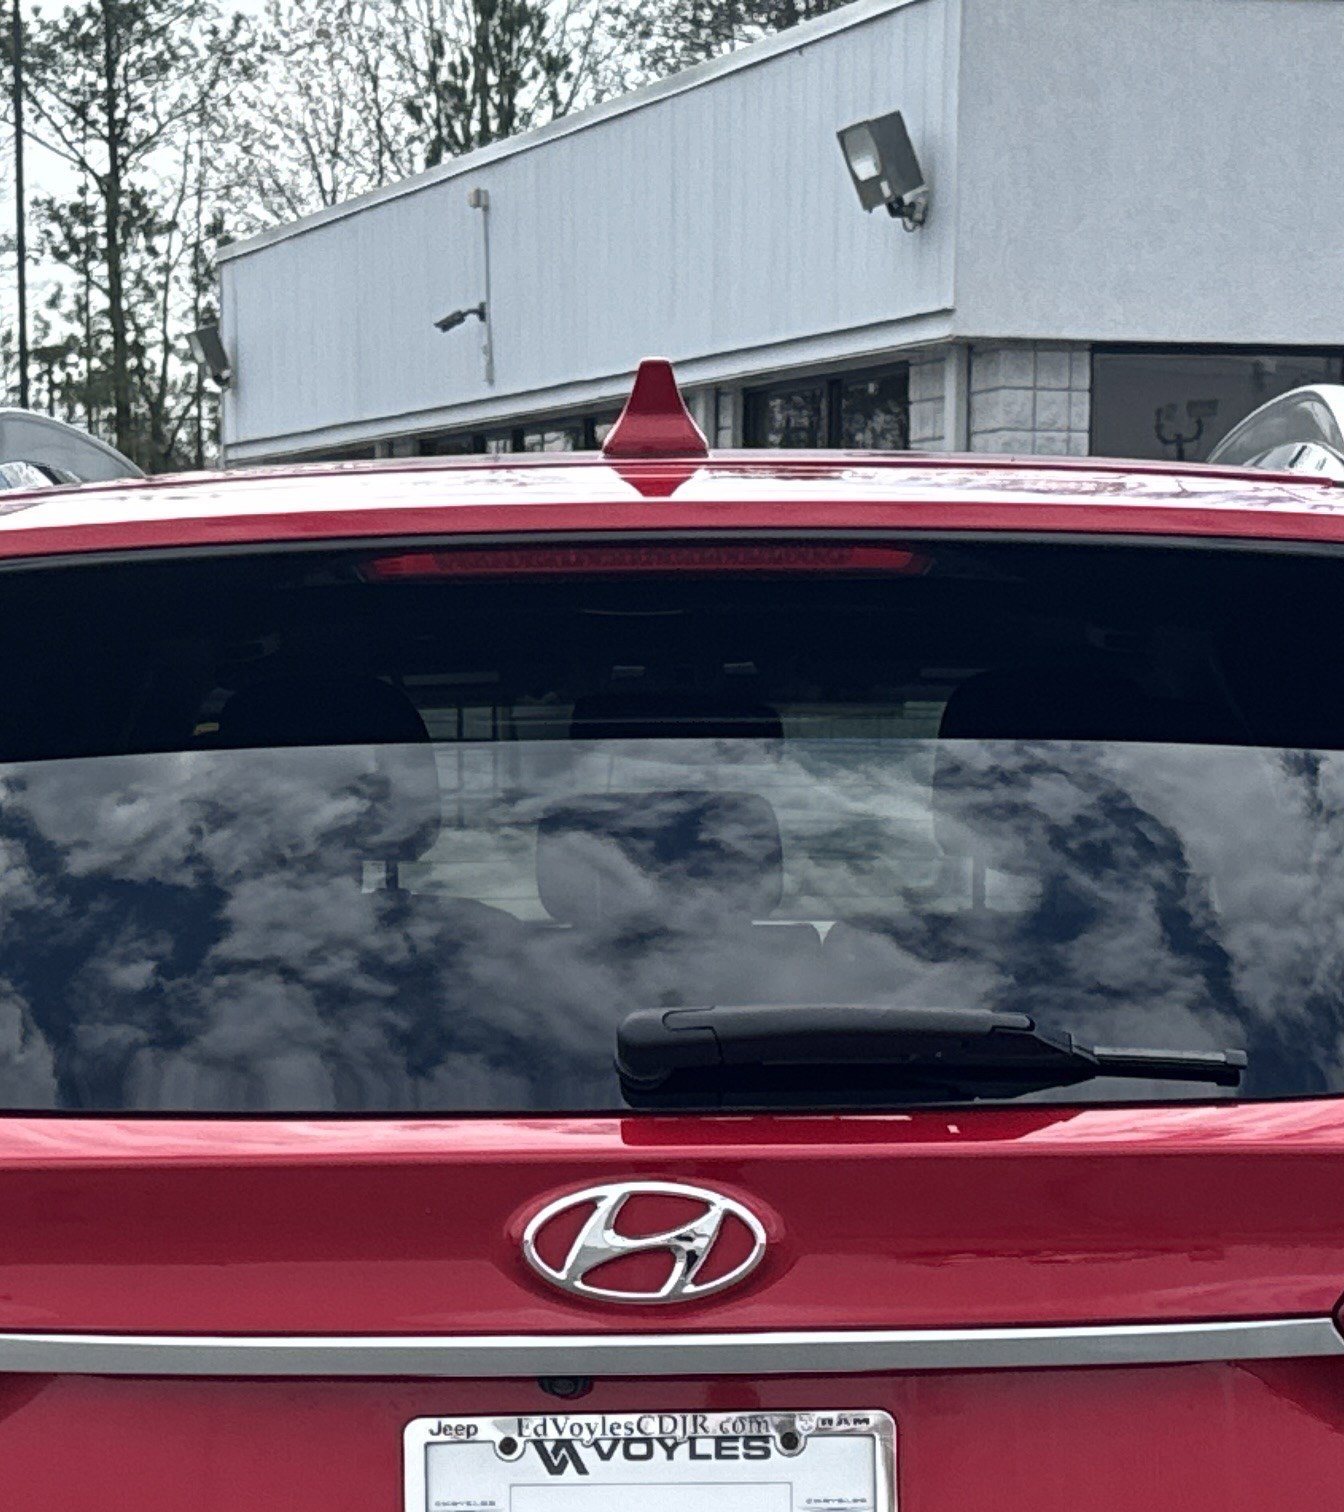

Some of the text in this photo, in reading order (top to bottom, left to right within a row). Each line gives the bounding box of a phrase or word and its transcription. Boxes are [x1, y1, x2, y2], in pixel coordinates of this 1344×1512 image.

[429, 1420, 479, 1439] Jeep
[820, 1416, 870, 1427] RAM
[592, 1437, 773, 1461] VOYLES
